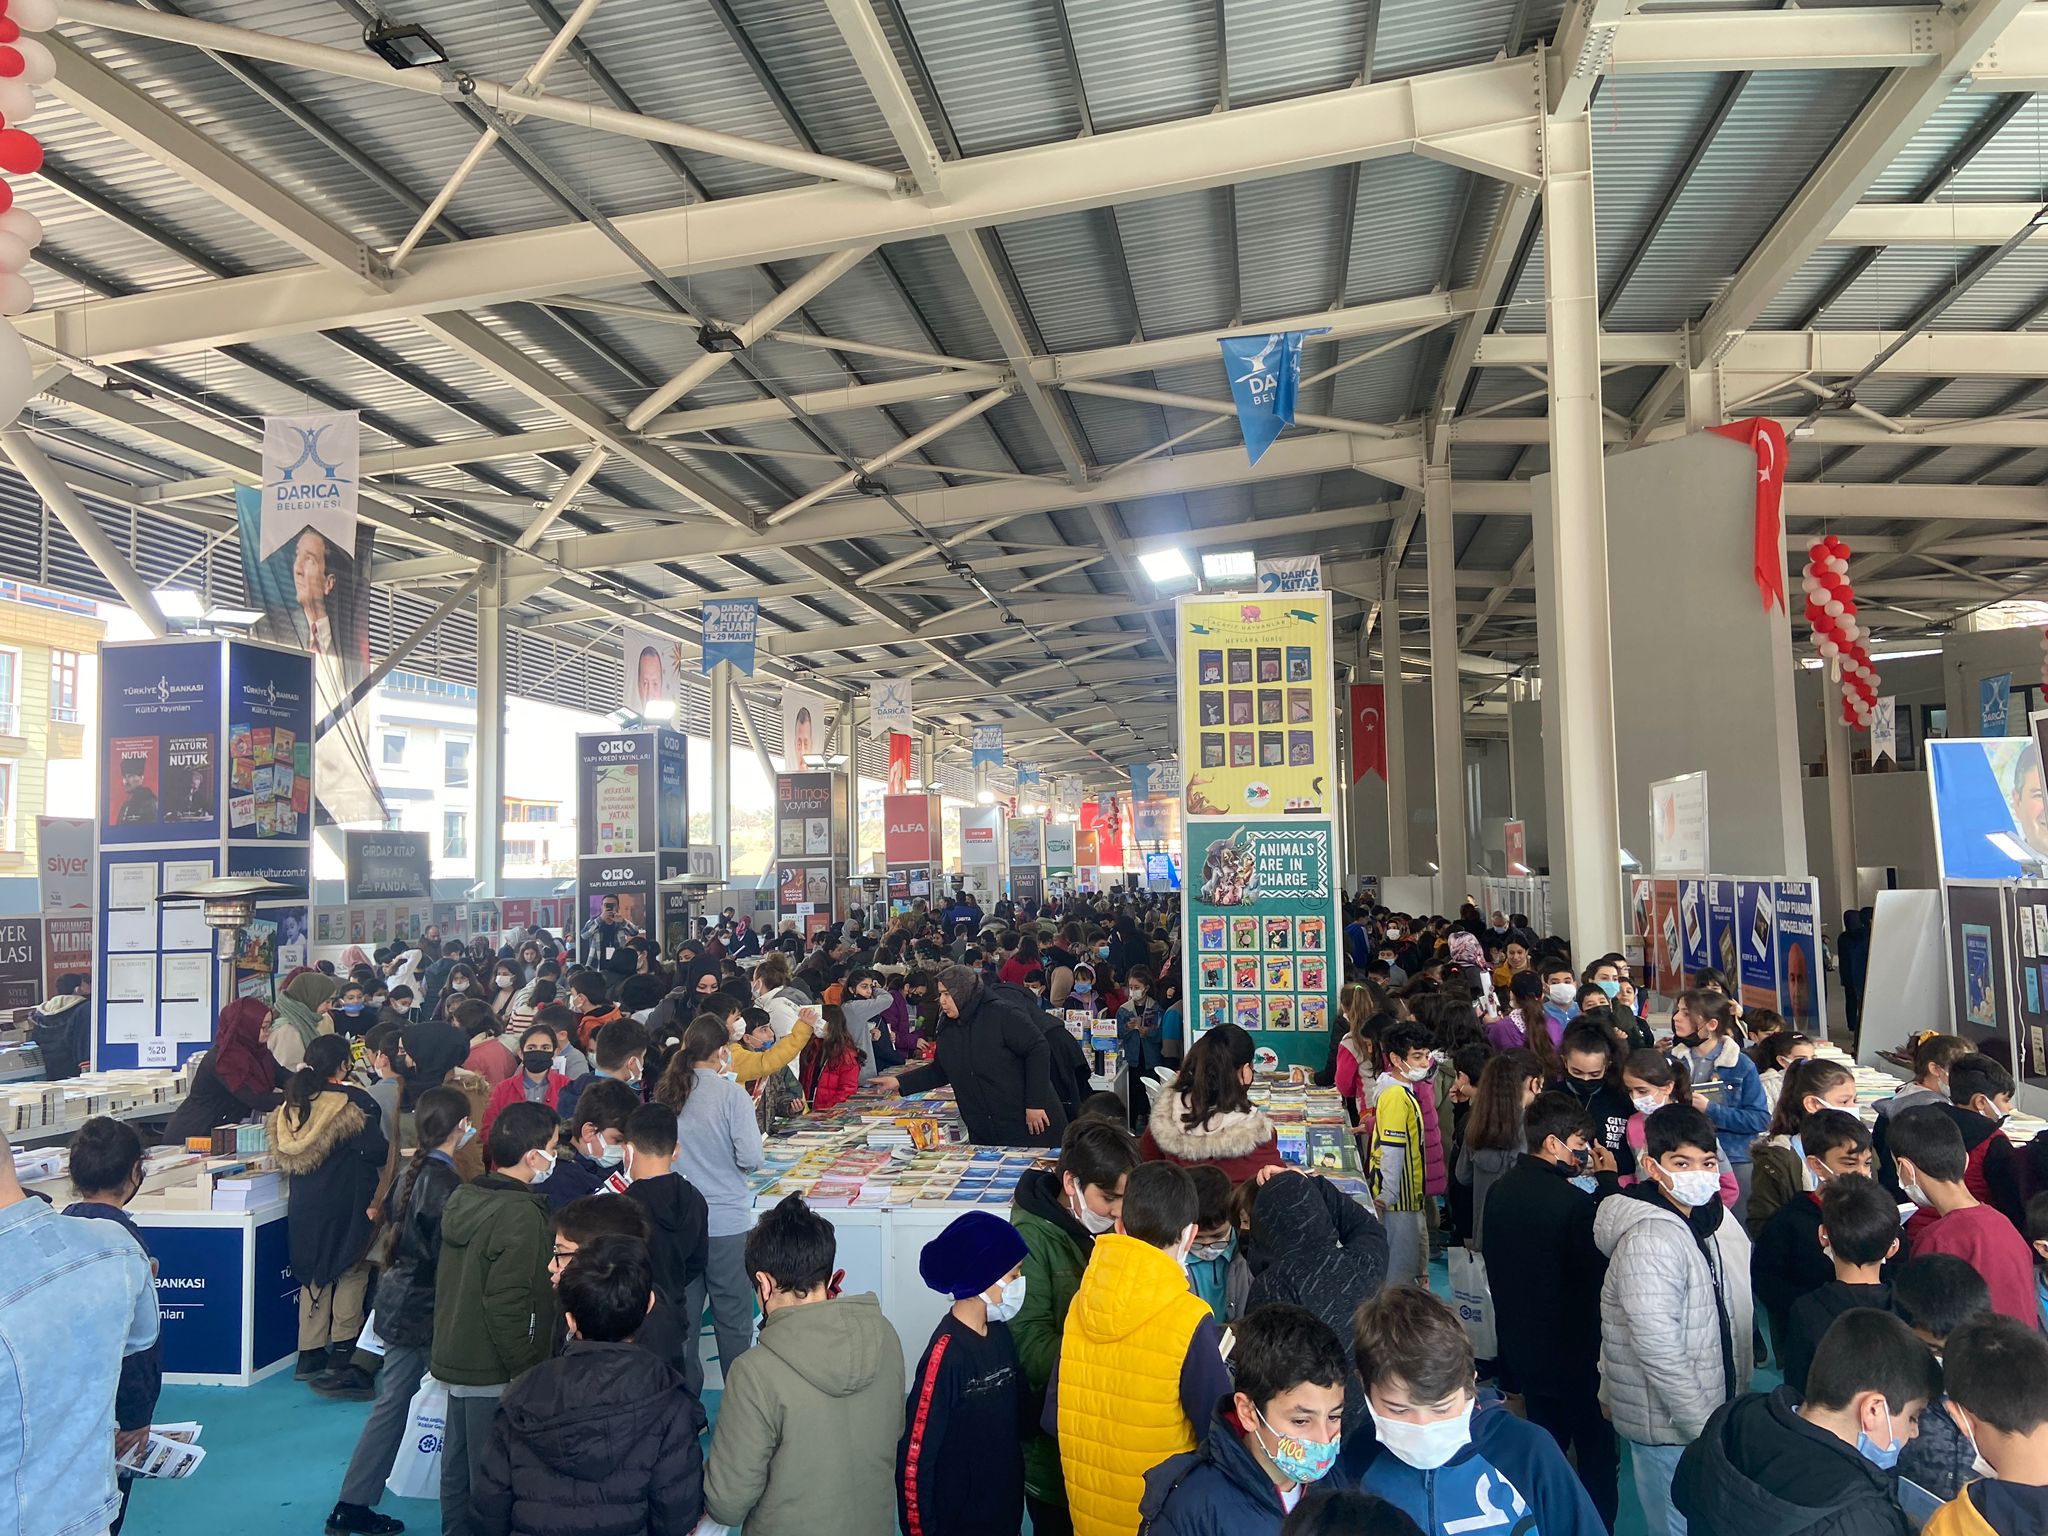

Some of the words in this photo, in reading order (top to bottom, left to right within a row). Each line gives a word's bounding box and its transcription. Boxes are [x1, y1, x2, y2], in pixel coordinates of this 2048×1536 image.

[277, 484, 340, 501] DARICA
[1281, 569, 1318, 579] DARICA
[720, 622, 754, 631] FUARI
[123, 686, 157, 696] TÜRKİYE
[170, 685, 204, 693] BANKASI
[243, 686, 267, 696] TÜRKİYE
[135, 706, 158, 714] Kültür
[159, 704, 191, 714] Yayınları
[169, 741, 208, 751] ATATÜRK
[598, 741, 636, 754] YKY
[121, 751, 149, 760] NUTUK
[169, 754, 208, 766] NUTUK
[598, 754, 618, 762] KREDİ
[618, 753, 651, 761] YAYINLARI
[890, 823, 925, 834] ALFA
[1259, 843, 1315, 856] ANIMALS
[47, 854, 88, 876] siyer
[1260, 858, 1284, 871] ARE
[1290, 858, 1303, 871] IN
[602, 868, 634, 880] YKY
[1260, 873, 1308, 886] CHARGE
[374, 881, 407, 892] PANDA
[51, 921, 91, 932] MUHAMMED
[0, 926, 27, 942] YER
[51, 932, 92, 953] YILDIR
[0, 946, 32, 963] LASI
[148, 1046, 167, 1055] %20
[155, 1278, 205, 1289] BANKASI
[159, 1309, 185, 1320] nları
